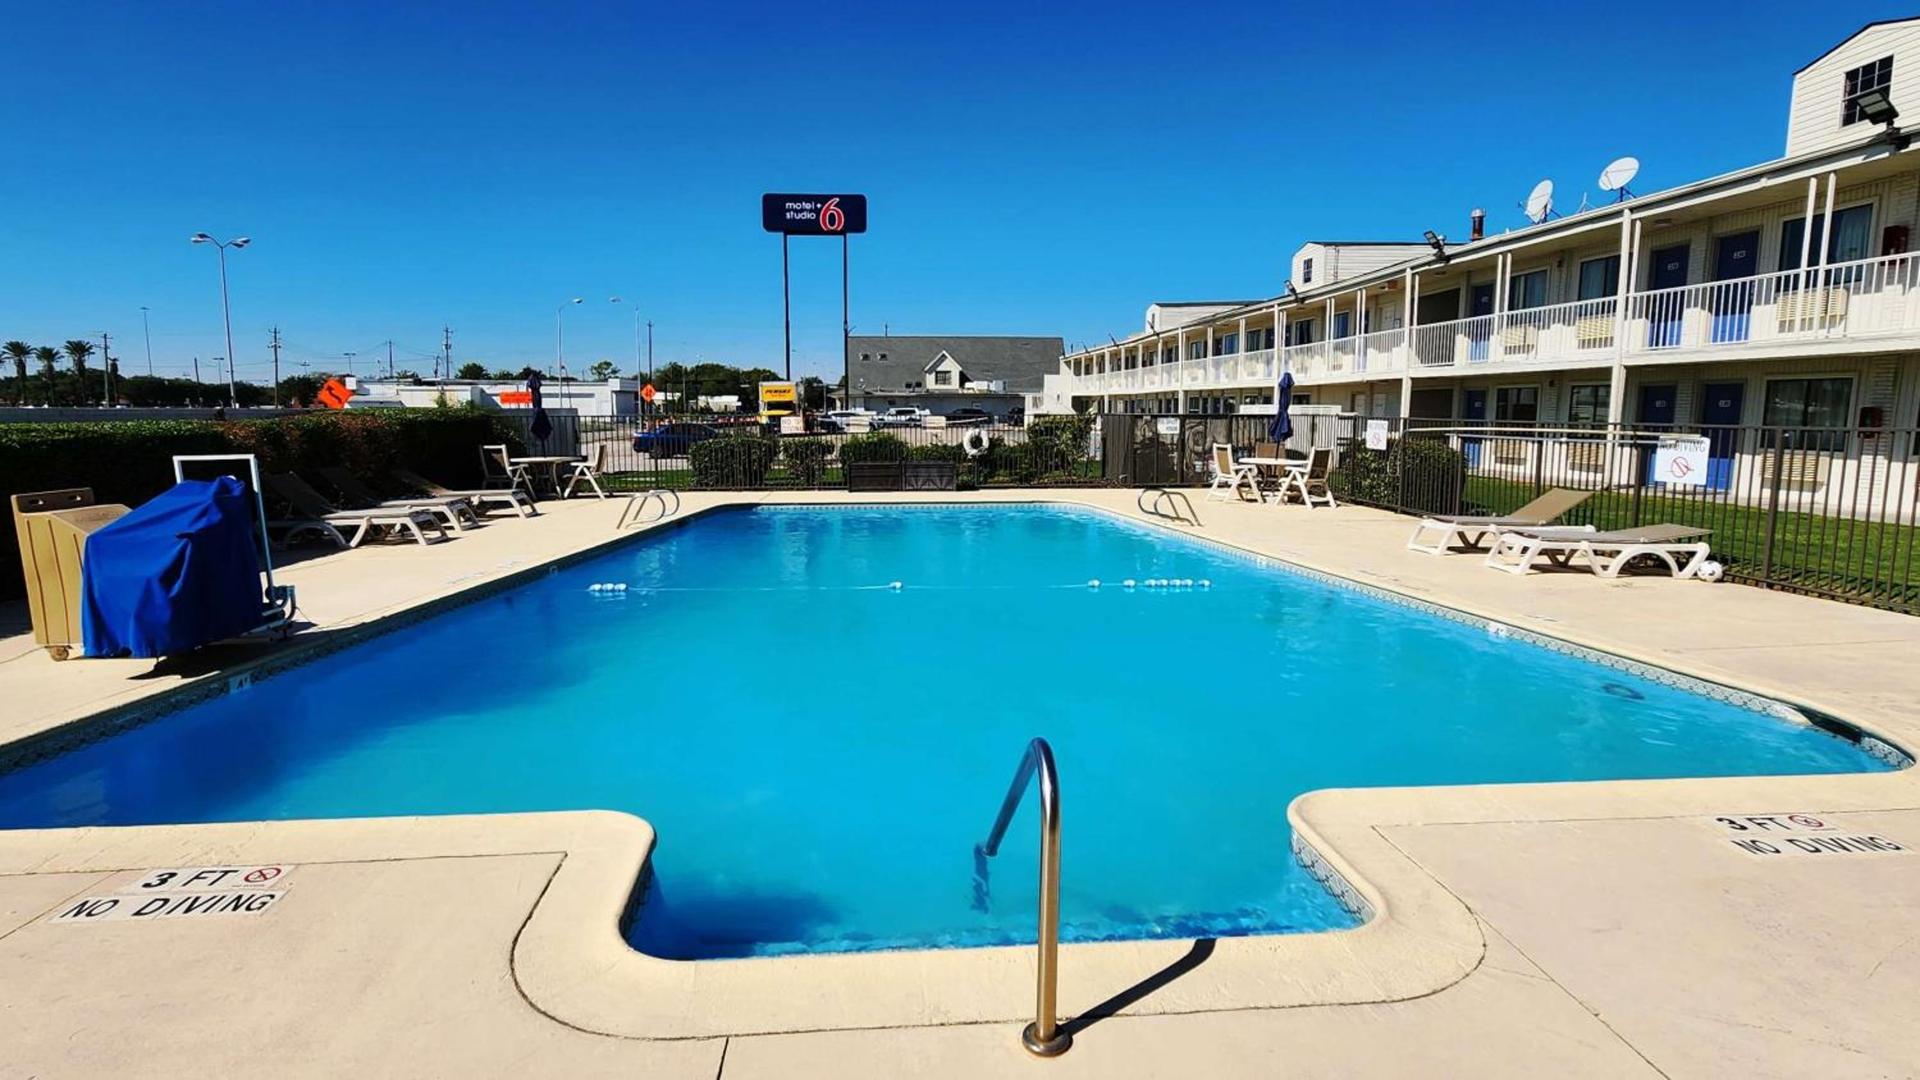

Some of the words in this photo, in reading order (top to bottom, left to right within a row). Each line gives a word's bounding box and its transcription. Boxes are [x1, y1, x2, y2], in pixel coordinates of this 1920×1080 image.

[785, 211, 816, 220] studio
[820, 197, 845, 231] 6
[1716, 817, 1748, 831] 3
[1744, 817, 1791, 831] FT
[1730, 839, 1782, 855] NO
[1785, 836, 1903, 853] DIVING
[141, 871, 178, 888] 3
[182, 869, 240, 887] FT
[59, 899, 121, 919] NO
[131, 894, 276, 917] DIVING
